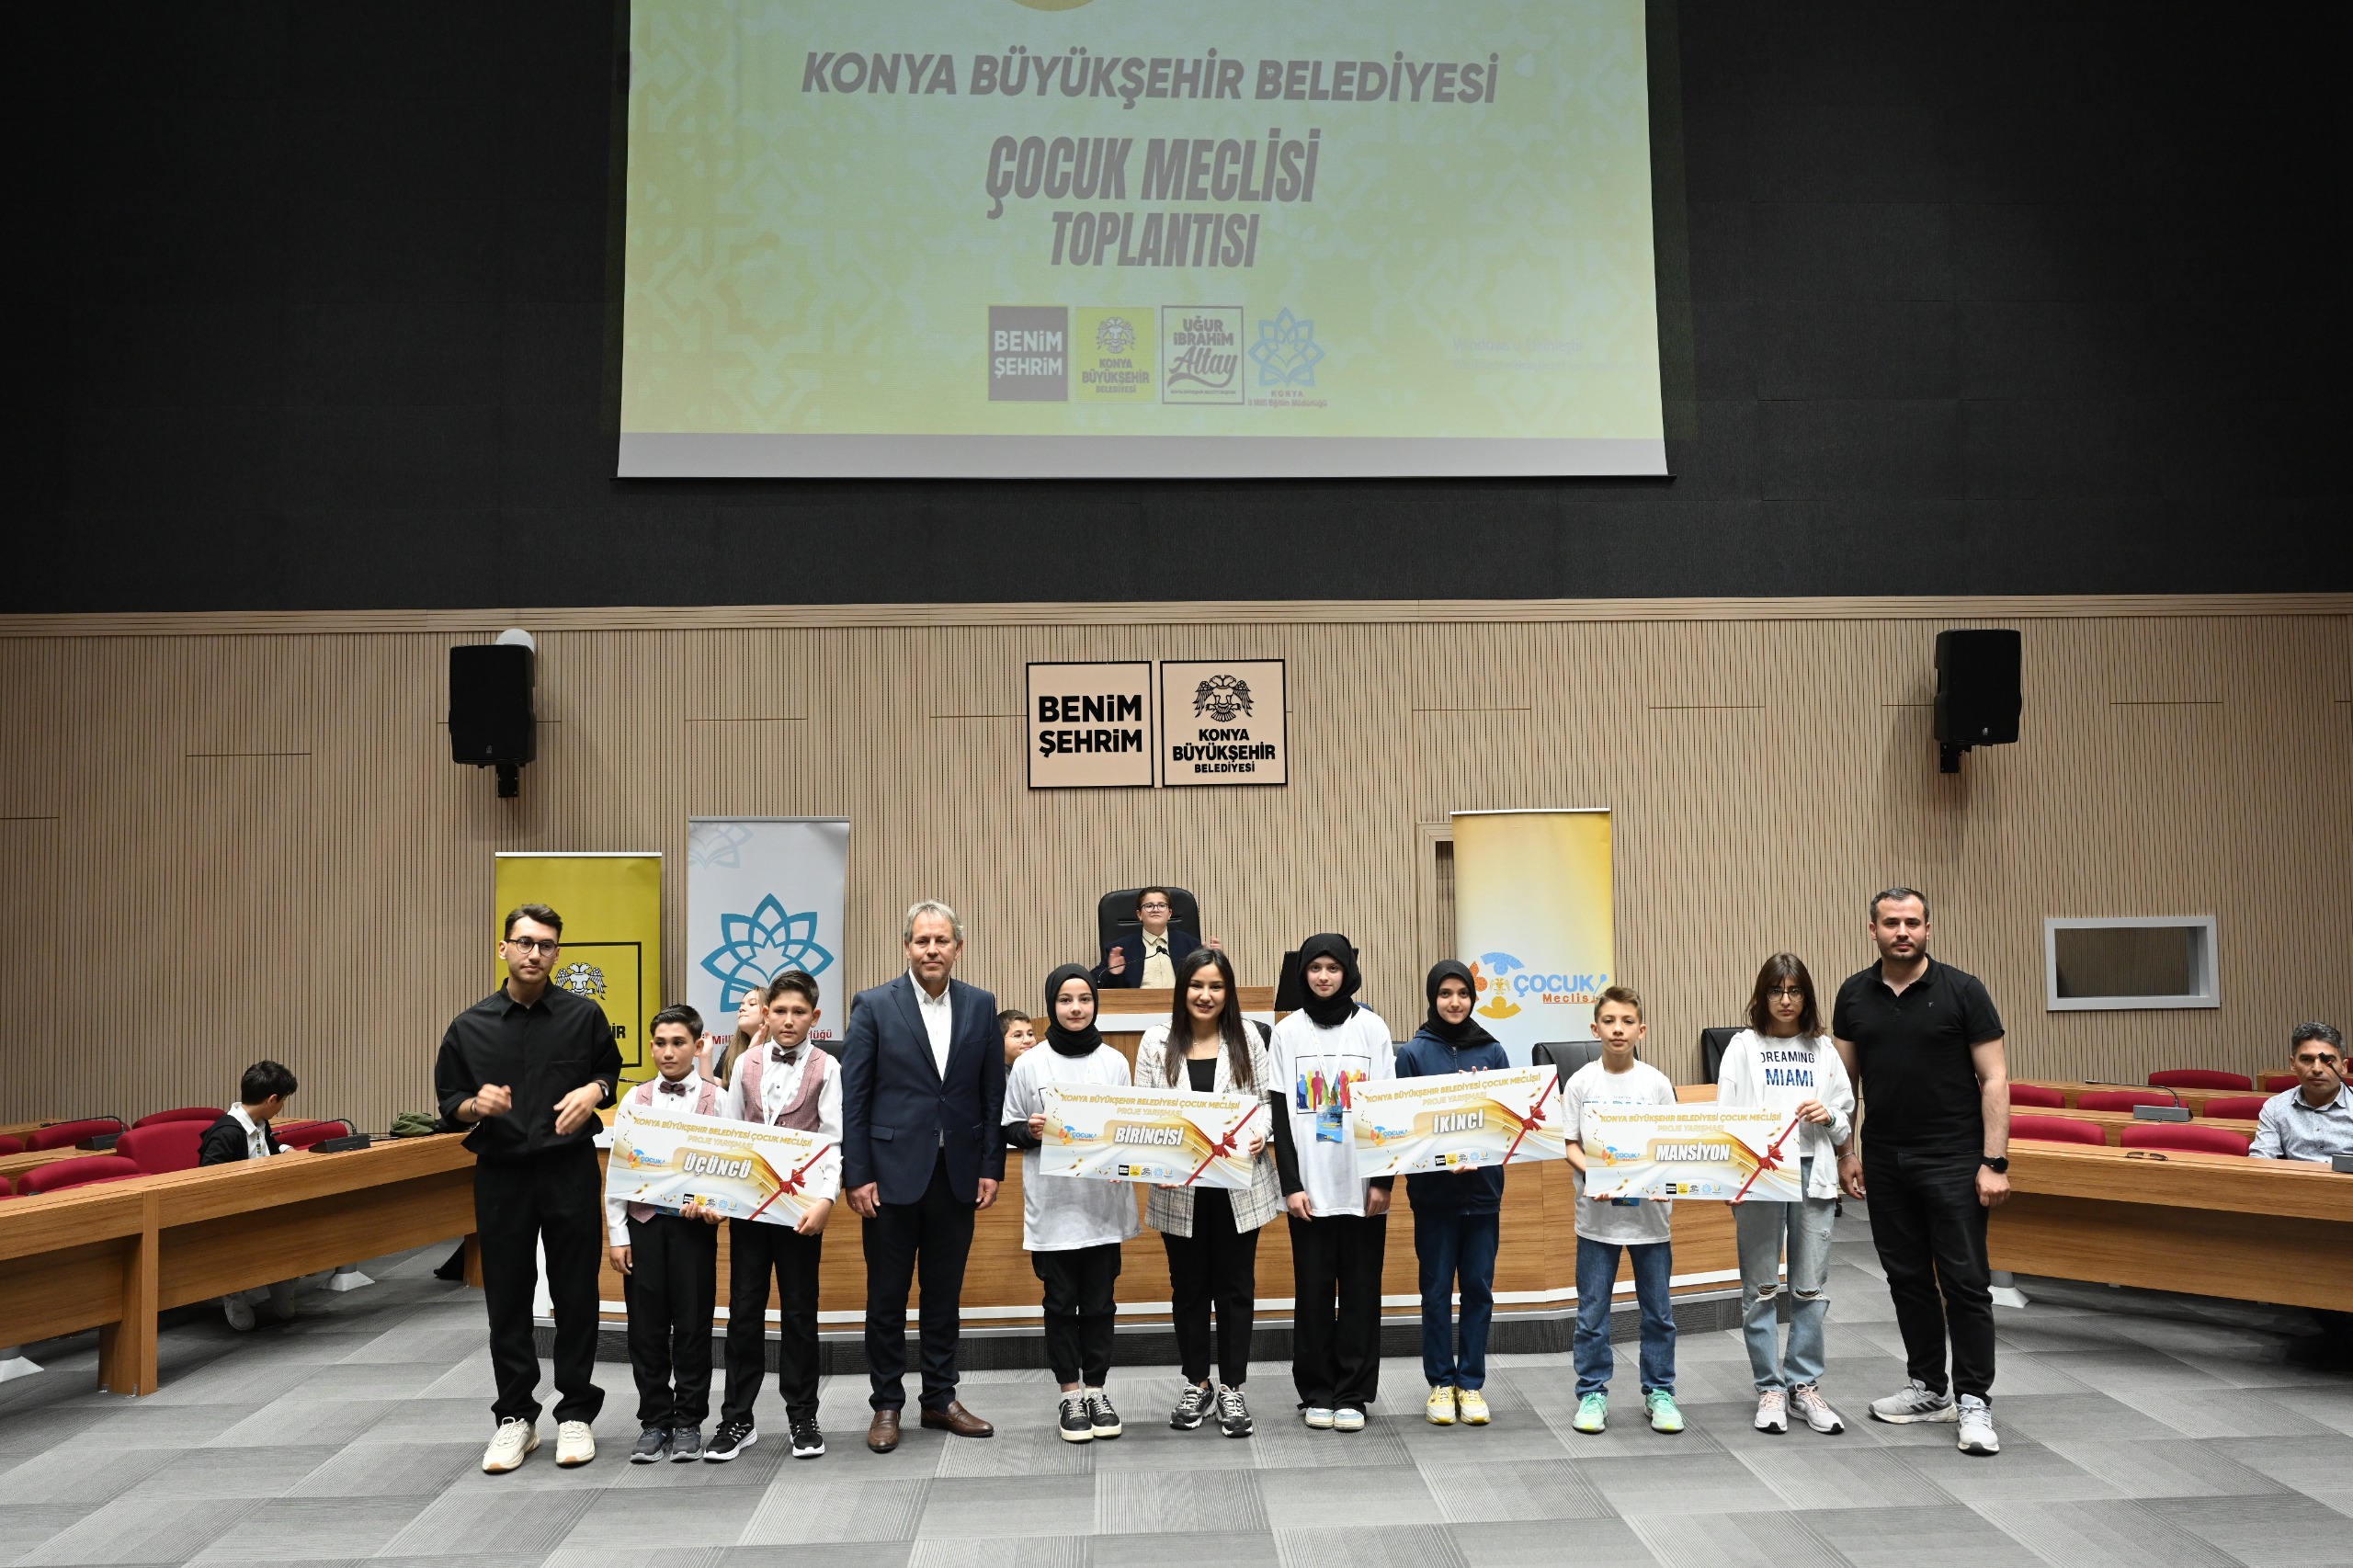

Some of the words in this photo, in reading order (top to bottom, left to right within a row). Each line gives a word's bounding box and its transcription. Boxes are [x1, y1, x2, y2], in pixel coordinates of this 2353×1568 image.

[801, 51, 957, 96] KONYA
[970, 45, 1245, 110] BÜYÜKŞEHİR
[1255, 50, 1500, 104] BELEDİYESİ
[985, 135, 1133, 220] ÇOCUK
[1141, 127, 1322, 203] MECLİSİ
[1051, 211, 1260, 267] TOPLANTISI
[1182, 315, 1223, 332] UĞUR
[1098, 358, 1133, 369] KONYA
[1082, 369, 1150, 385] BÜYÜKŞEHİR
[1199, 728, 1249, 742] KONYA
[1173, 742, 1276, 762] BÜYÜKŞEHİR
[1194, 762, 1255, 773] BELEDİYESİ
[1513, 974, 1595, 997] ÇOCUK
[1766, 1068, 1813, 1086] MIAMI
[1366, 1093, 1392, 1103] KONYA
[1482, 1078, 1509, 1089] ÇOCUK
[1061, 1094, 1088, 1102] KONYA
[1179, 1100, 1208, 1108] ÇOCUK
[1434, 1108, 1483, 1133] İKİNCİ
[1720, 1114, 1748, 1123] ÇOCUK
[633, 1117, 661, 1128] KONYA
[751, 1132, 780, 1143] ÇOCUK
[1114, 1124, 1184, 1145] BİRİNCİSİ
[1655, 1142, 1731, 1161] MANSİYON
[683, 1152, 752, 1178] ÜÇÜNCÜ
